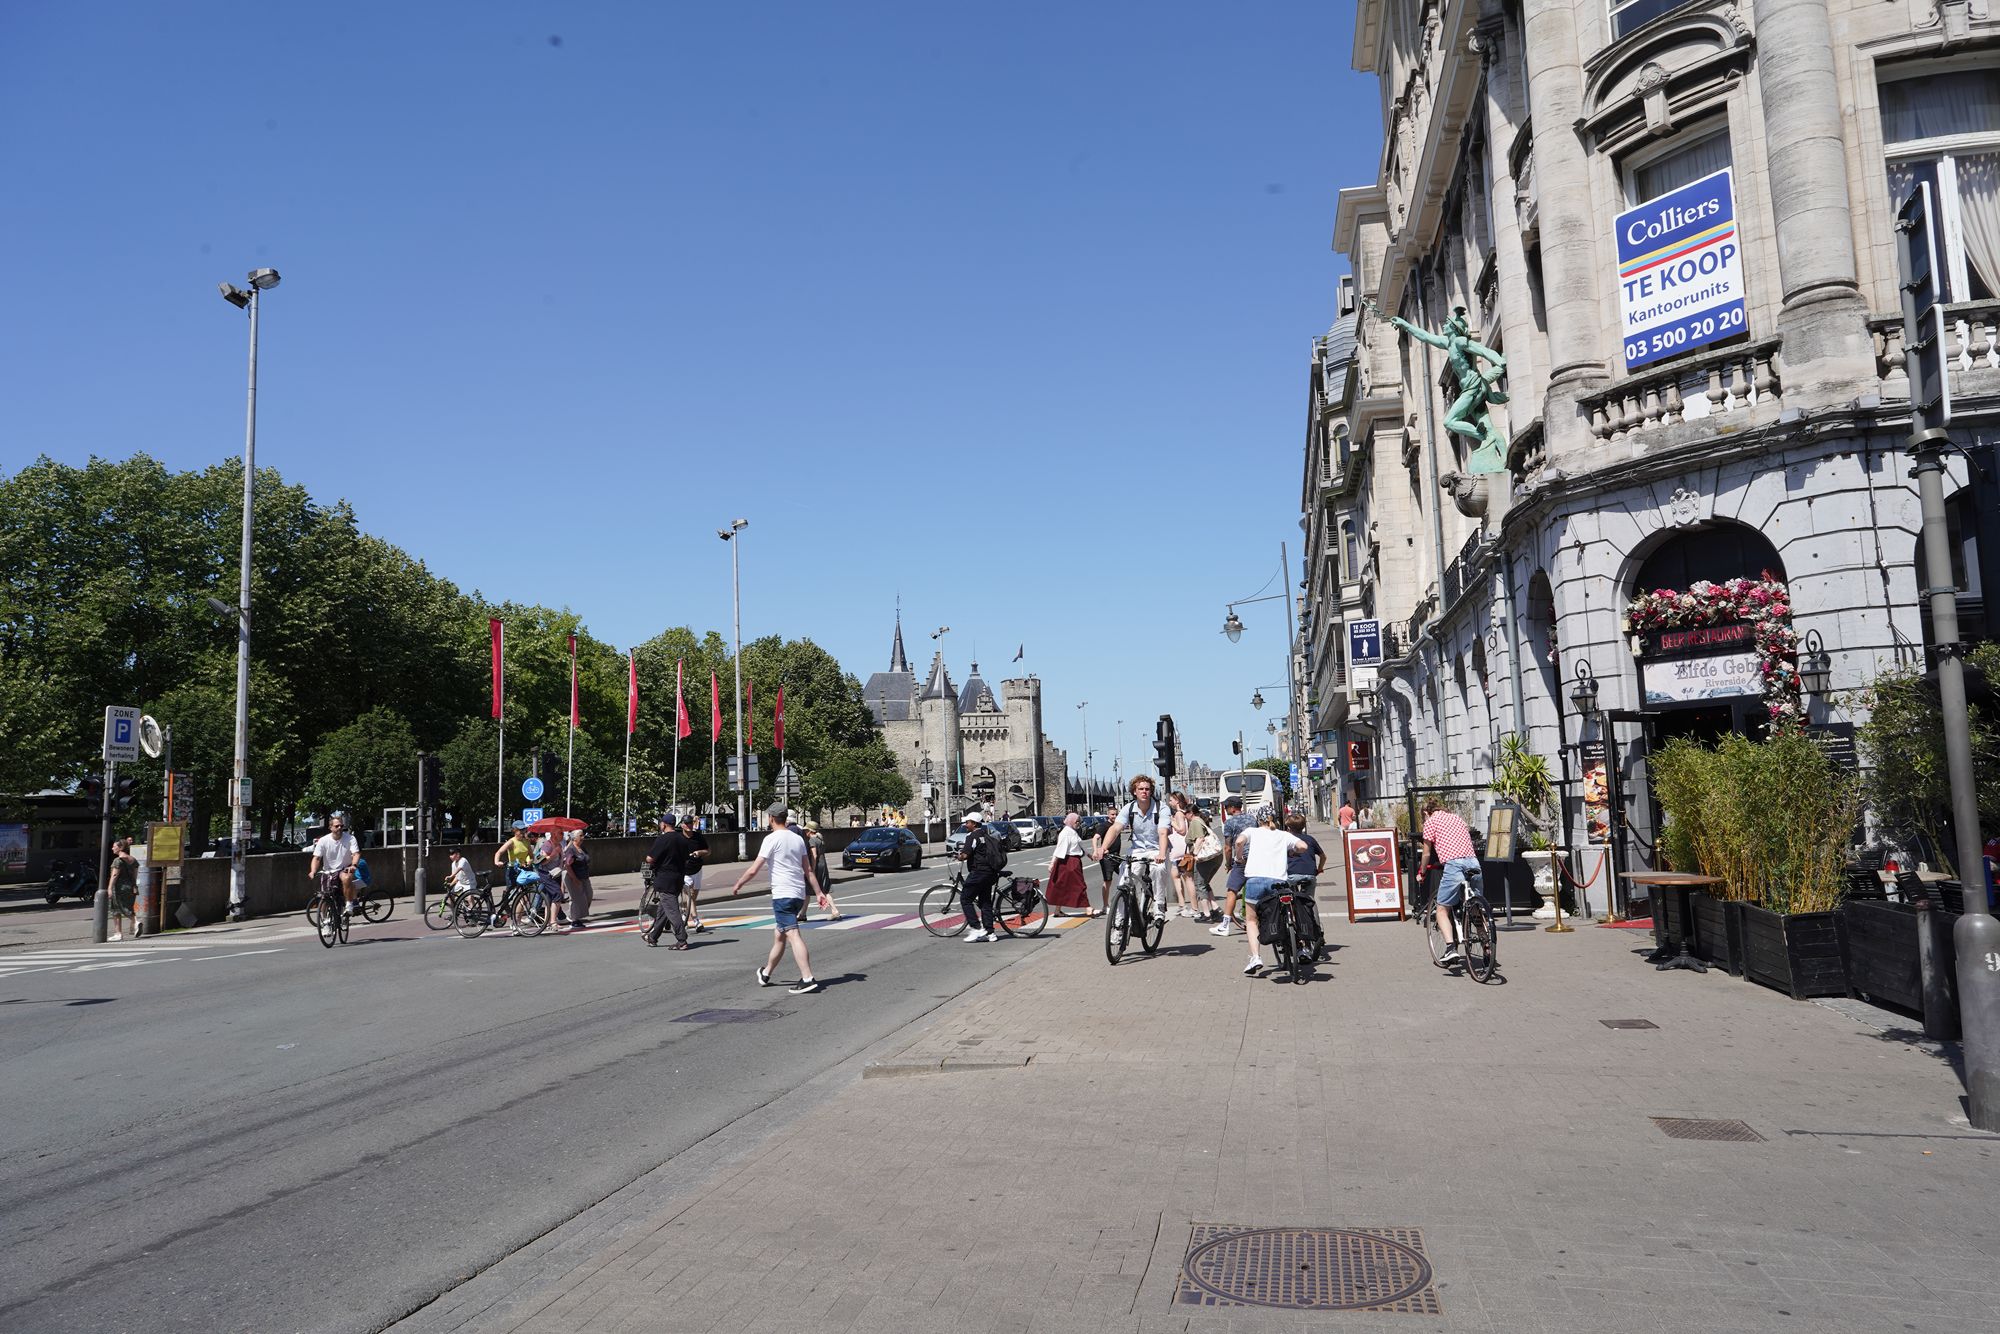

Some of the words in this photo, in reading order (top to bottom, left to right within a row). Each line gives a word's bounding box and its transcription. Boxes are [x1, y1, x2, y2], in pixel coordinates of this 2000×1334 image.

[1627, 198, 1720, 245] Colliers
[1623, 274, 1654, 303] TE
[1660, 243, 1736, 291] KOOP
[1628, 281, 1730, 325] Kantoorunits
[1626, 340, 1648, 361] 03
[1652, 327, 1687, 353] 500
[1690, 317, 1715, 340] 20
[1718, 307, 1743, 331] 20
[1359, 622, 1376, 630] KOOP
[1661, 632, 1685, 650] BEER
[1677, 661, 1718, 680] Elfde
[1705, 676, 1747, 688] Riverside
[113, 709, 135, 718] ZONE
[117, 722, 129, 739] P
[526, 811, 539, 821] 25
